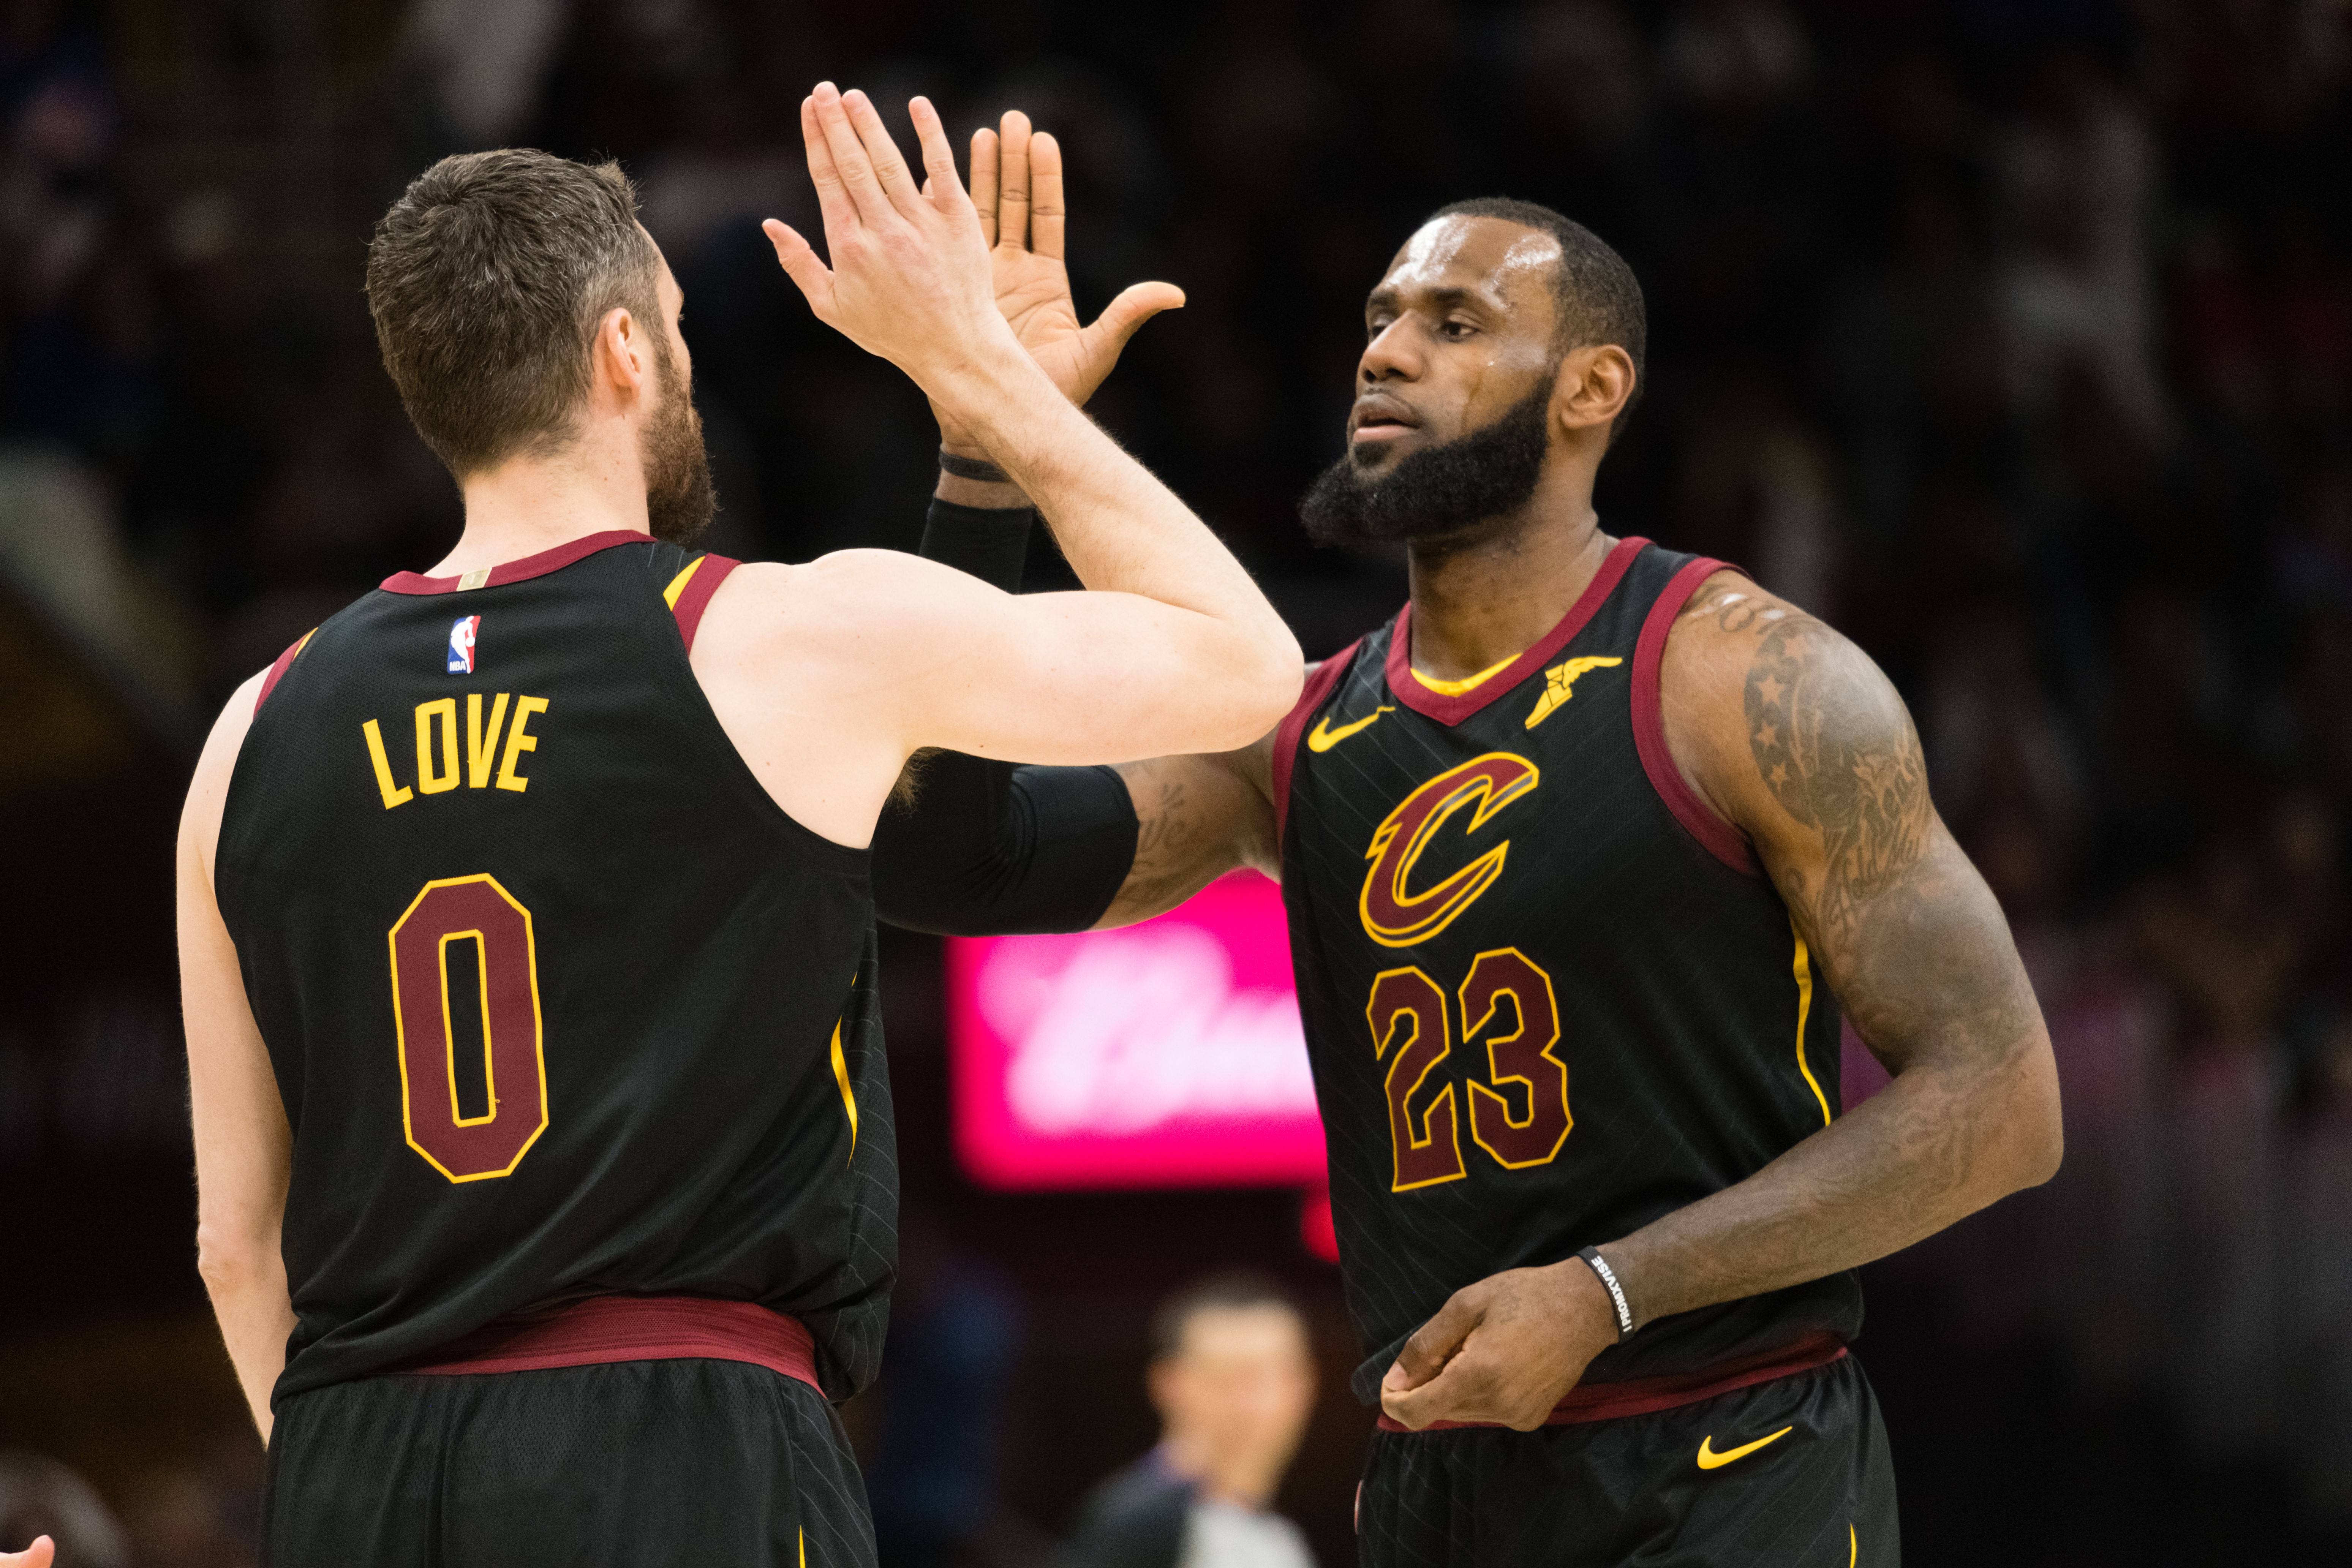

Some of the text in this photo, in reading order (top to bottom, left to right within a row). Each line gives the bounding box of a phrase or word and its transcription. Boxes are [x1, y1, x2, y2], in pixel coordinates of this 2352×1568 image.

[362, 693, 549, 810] LOVE
[450, 661, 466, 671] NBA
[1359, 752, 1539, 947] C
[389, 873, 549, 1184] 0
[1366, 947, 1574, 1192] 23
